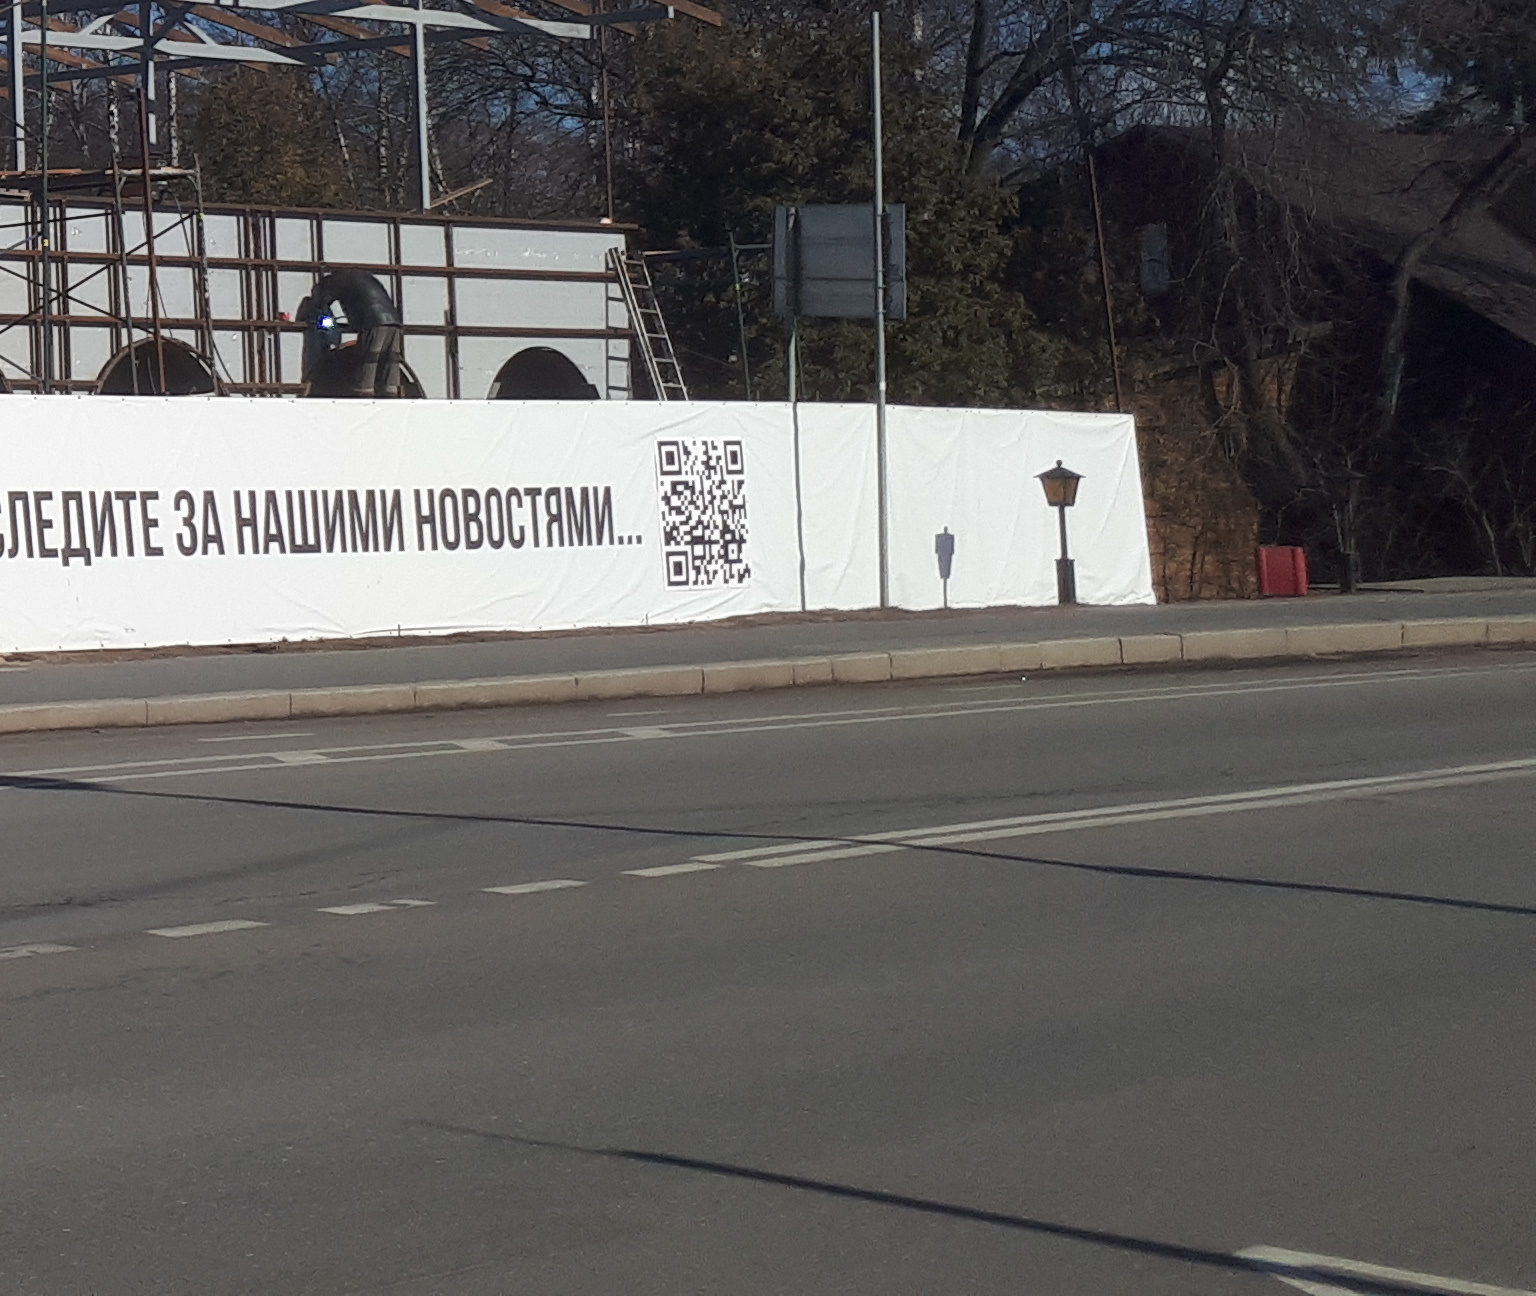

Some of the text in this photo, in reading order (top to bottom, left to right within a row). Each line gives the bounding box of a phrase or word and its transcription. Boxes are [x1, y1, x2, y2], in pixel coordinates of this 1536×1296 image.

[174, 489, 226, 557] ЗА
[233, 488, 405, 555] НАШИМИ
[413, 485, 644, 552] НОВОСТЯМИ...
